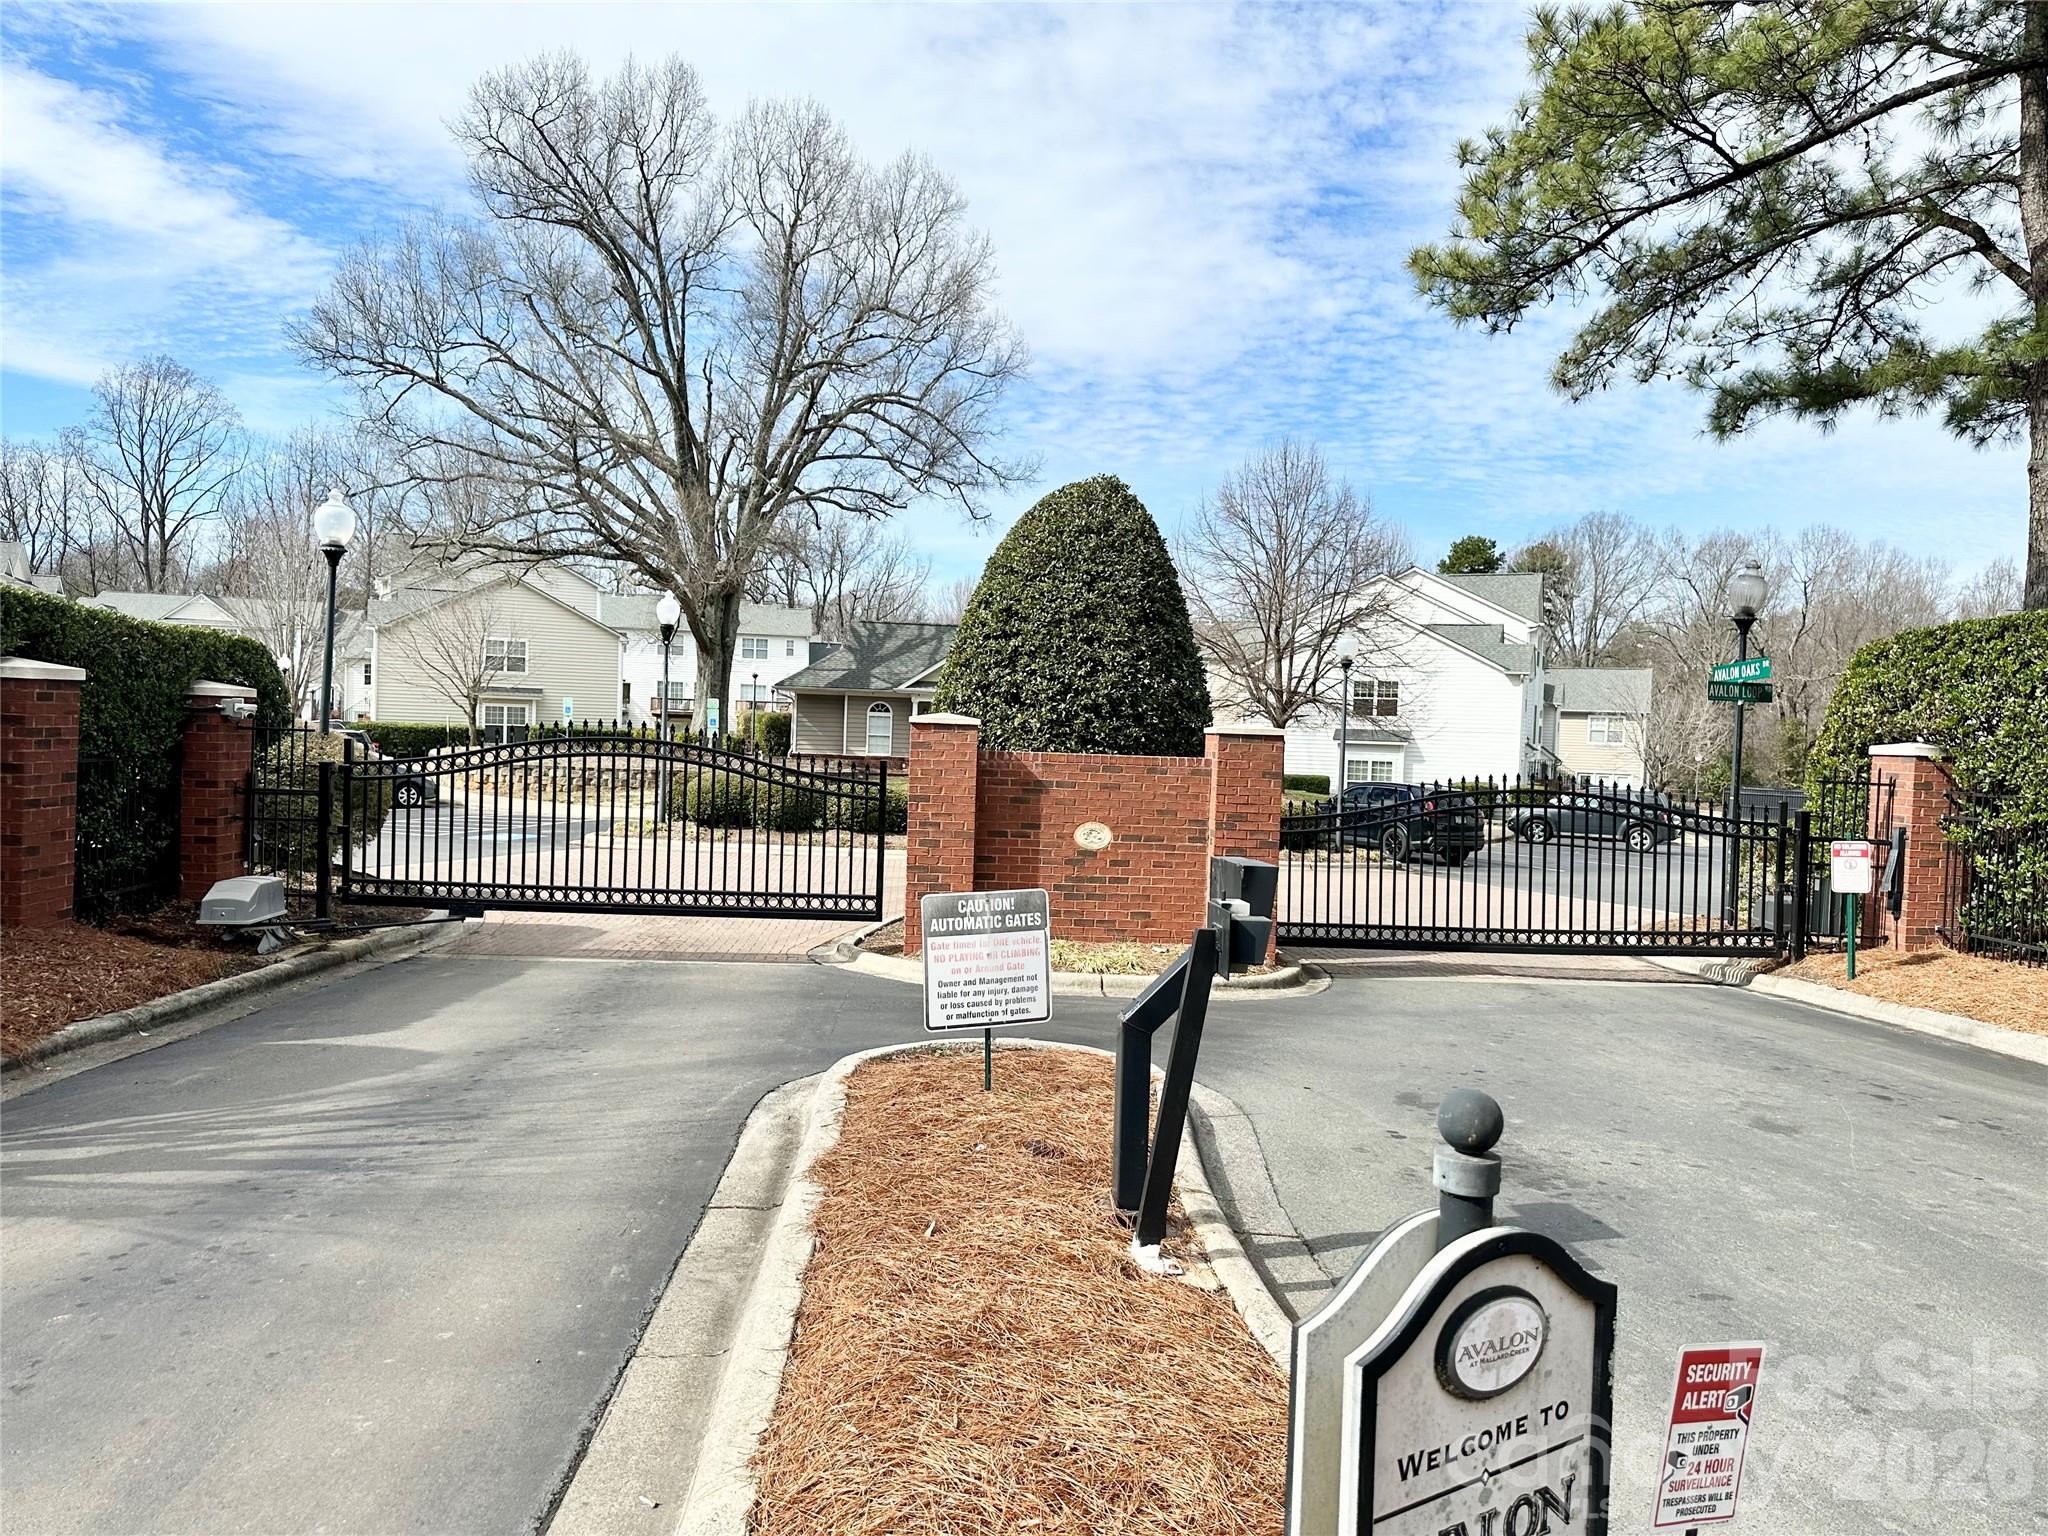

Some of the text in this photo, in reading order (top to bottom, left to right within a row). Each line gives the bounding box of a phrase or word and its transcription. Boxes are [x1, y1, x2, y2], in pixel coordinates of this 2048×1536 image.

[1714, 666, 1740, 681] AVALON
[1741, 662, 1760, 678] OAKS
[1709, 684, 1739, 697] AVALON
[1742, 686, 1762, 698] LOOP
[958, 897, 1015, 913] CAUTION!
[930, 912, 1041, 932] AUTOMATIC GATES
[930, 942, 950, 951] Gate
[953, 940, 976, 949] timed
[993, 938, 1009, 946] ONE
[934, 954, 946, 964] NO
[948, 952, 984, 963] PLAYING
[1000, 948, 1041, 959] CLIMBING
[951, 967, 961, 975] on
[975, 963, 1004, 973] Around
[1007, 962, 1025, 971] Gate
[938, 979, 960, 988] Owner
[963, 978, 977, 986] and
[979, 975, 1025, 985] Management
[937, 985, 1038, 999] liable for any injury, damage
[950, 1001, 964, 1009] loss
[967, 999, 992, 1008] caused
[994, 998, 1002, 1007] by
[1004, 996, 1036, 1006] problems
[956, 1010, 999, 1019] malfunction
[1001, 1008, 1008, 1016] of
[1010, 1007, 1031, 1016] gates.
[1458, 1326, 1540, 1363] AVALON
[1470, 1360, 1478, 1368] AT
[1686, 1361, 1752, 1383] SECURITY
[1681, 1389, 1727, 1410] ALERT
[1540, 1400, 1569, 1426] TO
[1677, 1428, 1740, 1444] THIS PROPERTY
[1692, 1443, 1719, 1456] UNDER
[1687, 1458, 1734, 1476] 24 HOUR
[1668, 1475, 1732, 1493] SURVEILLANCE
[1662, 1491, 1733, 1507] TRESPASSERS WILL BE
[1676, 1504, 1716, 1517] PROSECUTED
